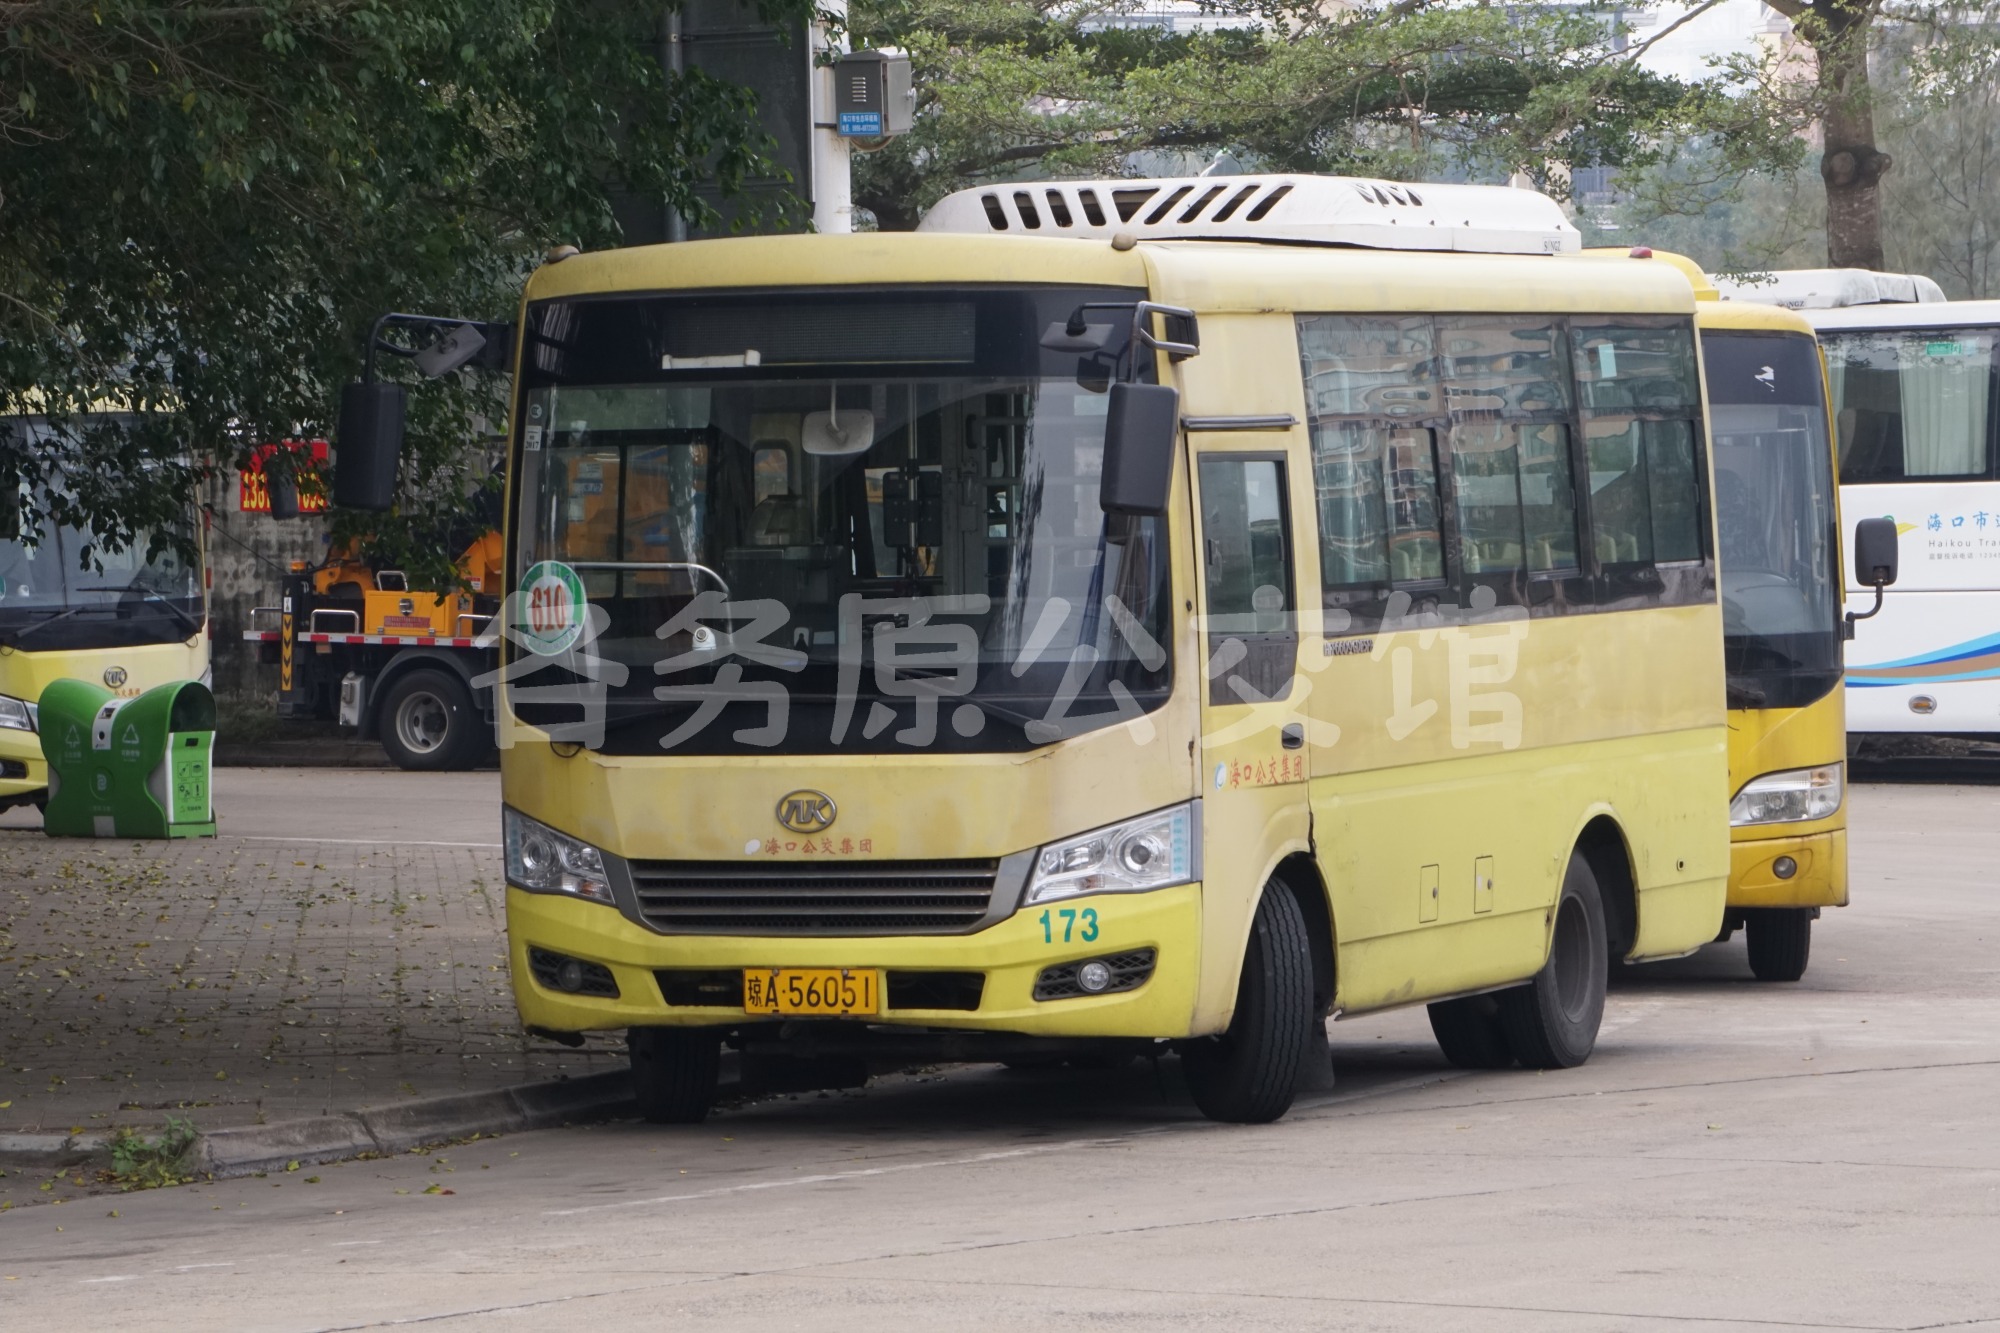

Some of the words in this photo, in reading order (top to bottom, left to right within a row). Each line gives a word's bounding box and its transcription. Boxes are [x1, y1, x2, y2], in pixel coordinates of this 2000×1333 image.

[1928, 539, 1971, 548] Haikou
[1979, 539, 2000, 548] Tra
[532, 584, 566, 633] 610
[1230, 754, 1303, 789] 海口公交集团
[765, 838, 872, 855] 海口公交集团
[1039, 908, 1099, 943] 173
